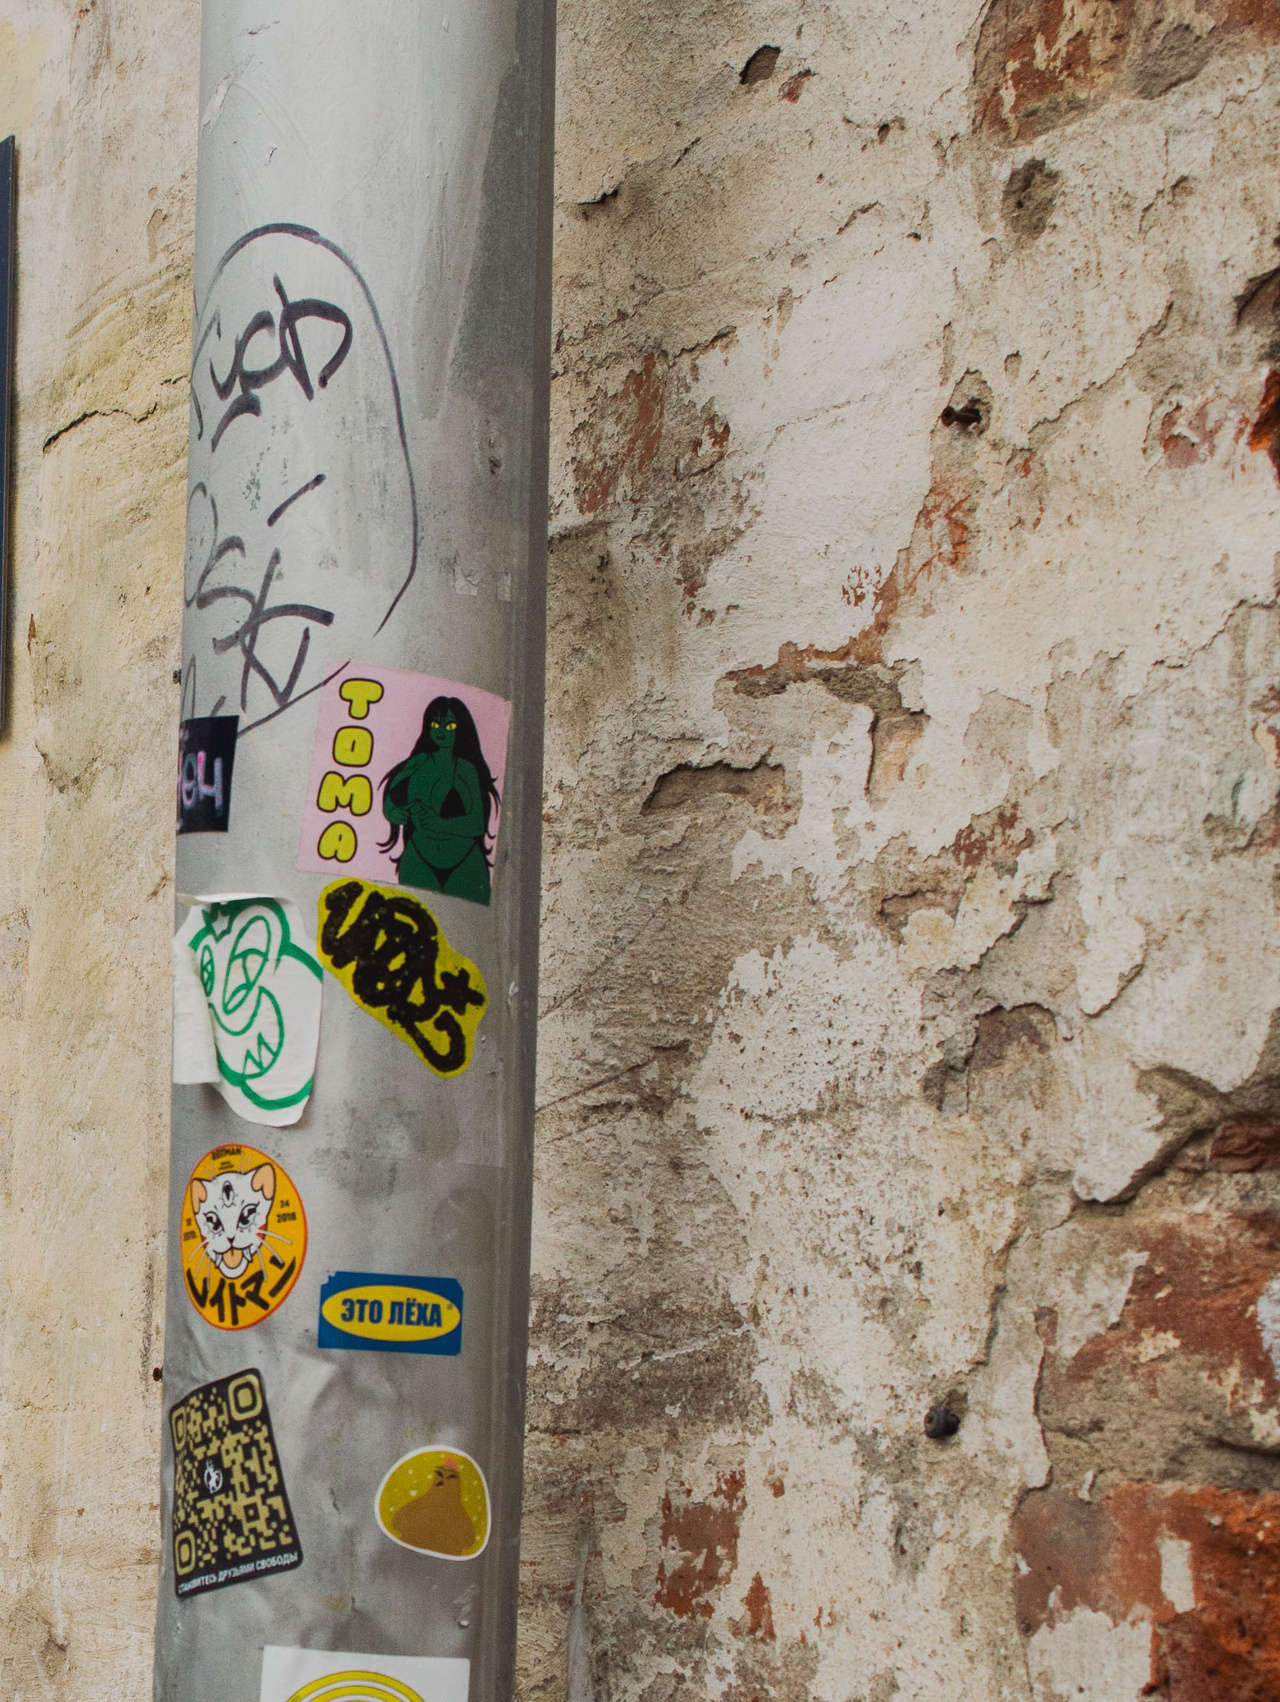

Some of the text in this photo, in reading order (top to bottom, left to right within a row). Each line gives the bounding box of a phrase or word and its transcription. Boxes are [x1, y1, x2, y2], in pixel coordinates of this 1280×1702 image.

[187, 1255, 296, 1326] レイトマン
[340, 1297, 442, 1327] ЭТО ЛЁХА
[218, 1562, 255, 1583] ДРУЗЬЯМИ
[255, 1551, 299, 1570] СВОБОДЫ
